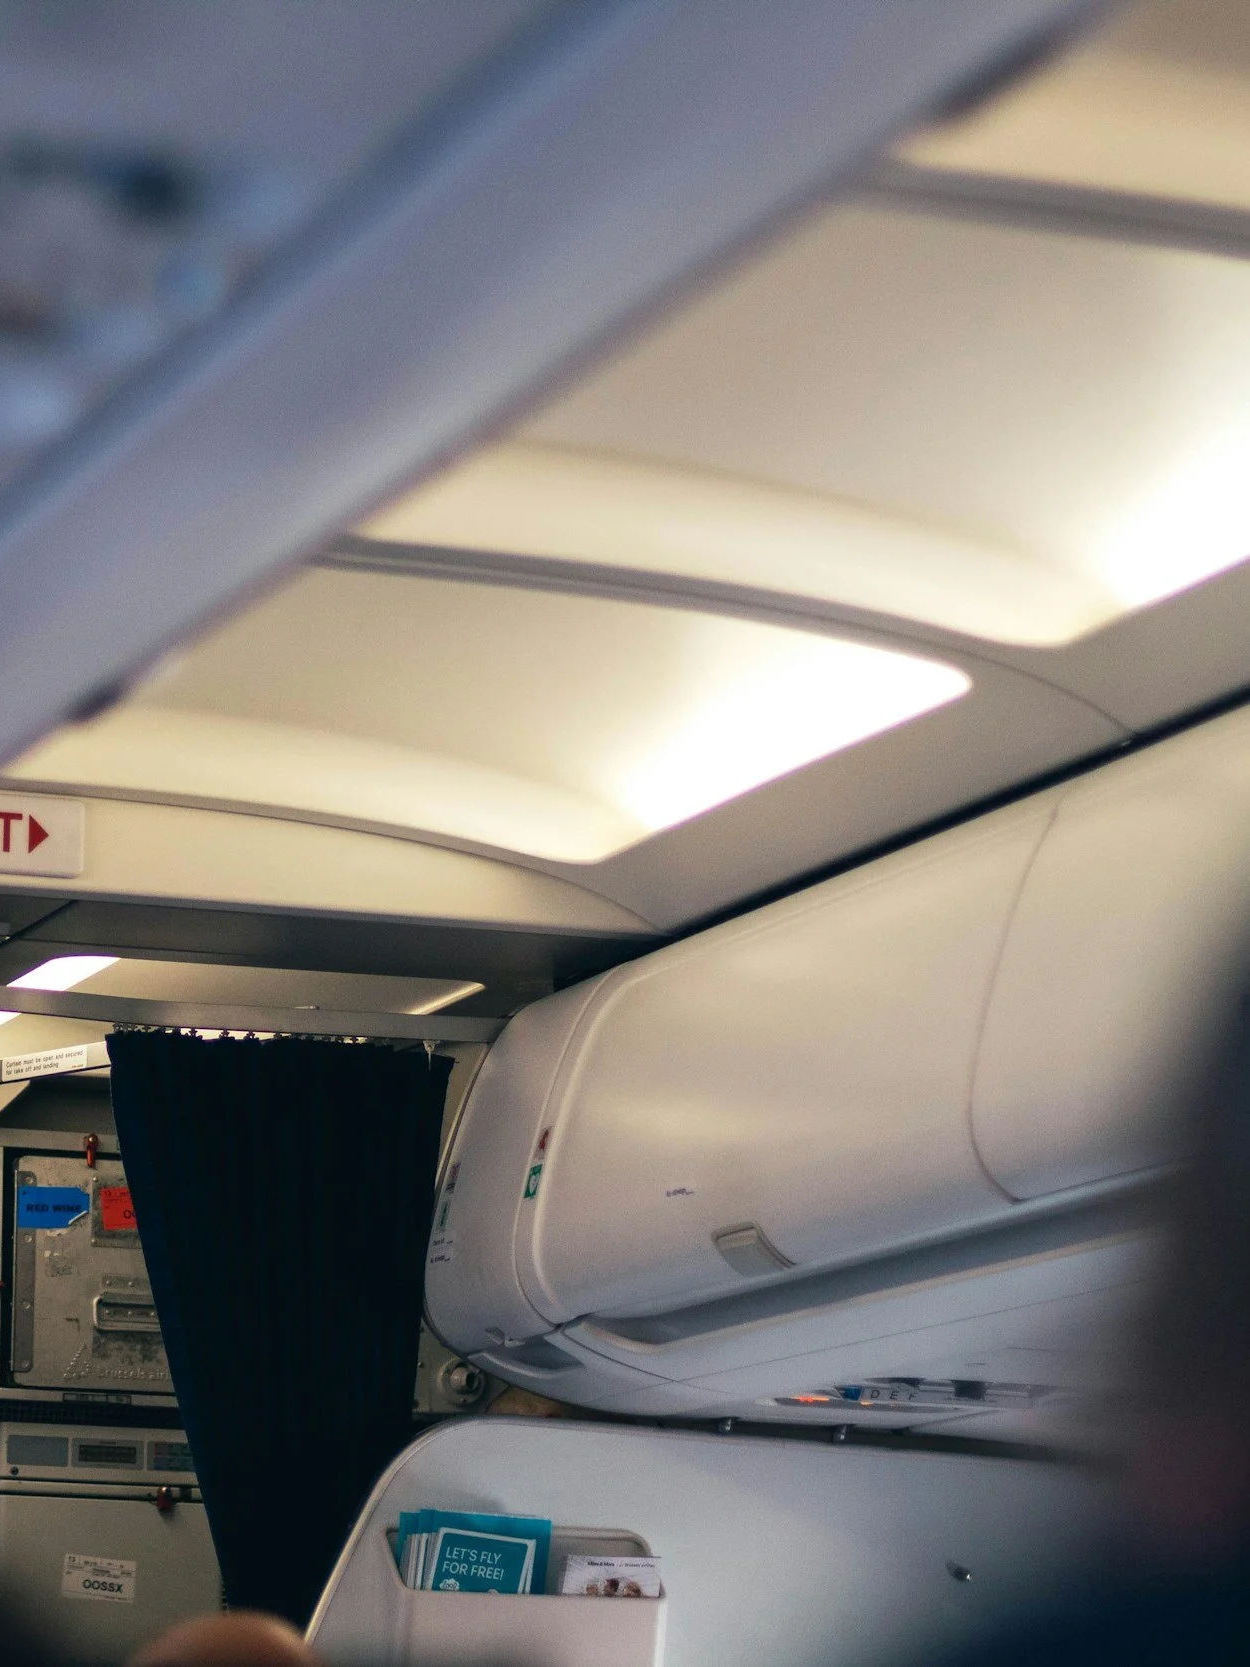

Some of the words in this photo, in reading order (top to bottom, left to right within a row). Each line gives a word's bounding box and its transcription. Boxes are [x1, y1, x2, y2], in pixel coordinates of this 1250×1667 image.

[6, 1060, 22, 1068] Curtain
[65, 1050, 83, 1058] secured
[43, 1062, 59, 1070] landing
[26, 1203, 49, 1213] RED
[53, 1204, 82, 1213] WINE
[871, 1389, 880, 1399] D
[889, 1391, 898, 1400] E
[909, 1392, 918, 1401] F
[445, 1546, 478, 1562] LET'S
[480, 1551, 502, 1565] FLY
[442, 1561, 469, 1576] FOR
[470, 1564, 505, 1581] FREE!
[83, 1579, 123, 1593] OOSSX
